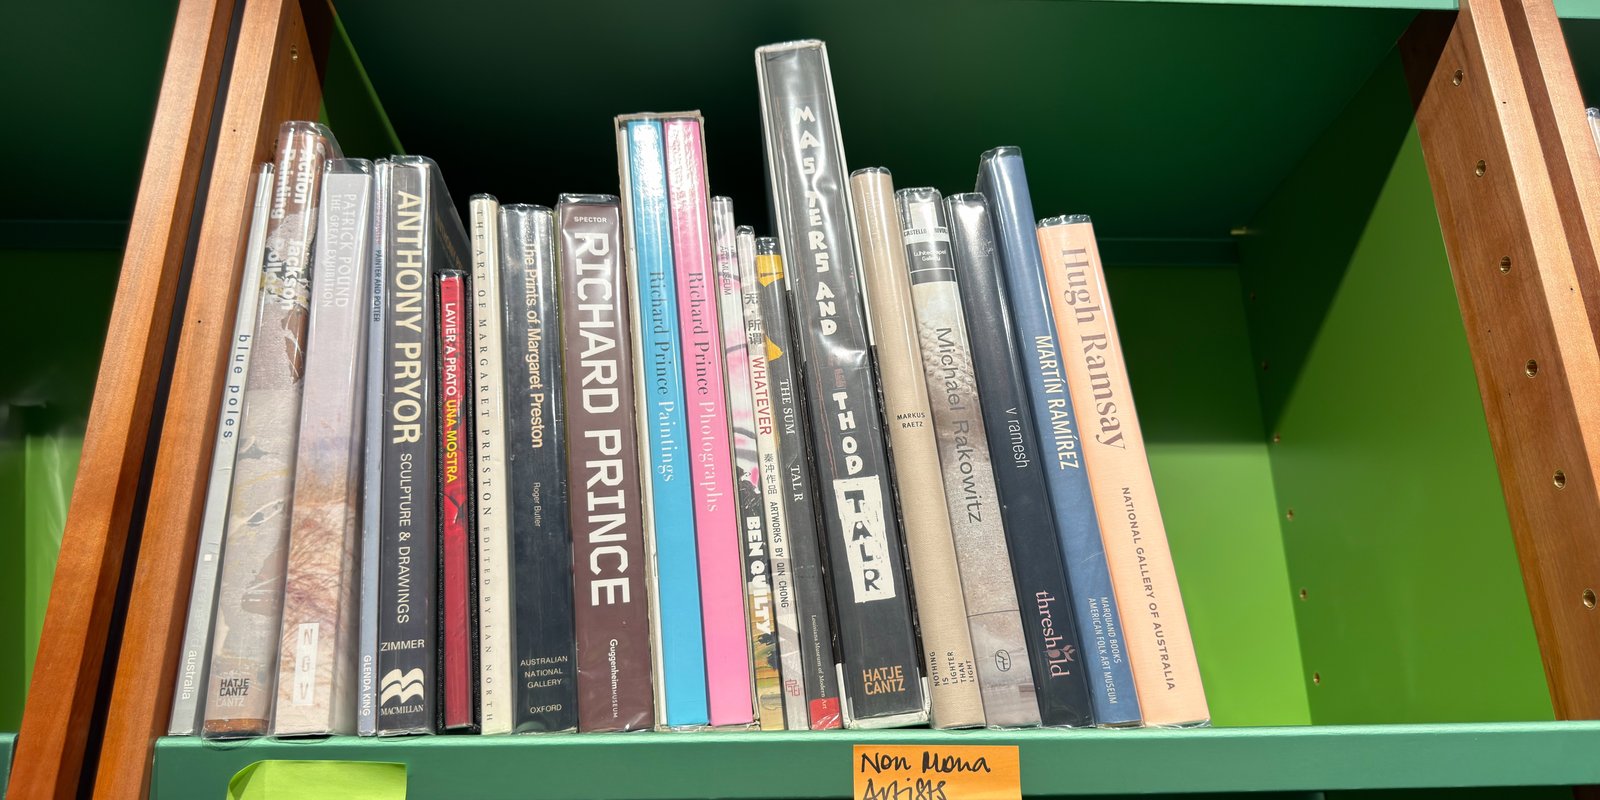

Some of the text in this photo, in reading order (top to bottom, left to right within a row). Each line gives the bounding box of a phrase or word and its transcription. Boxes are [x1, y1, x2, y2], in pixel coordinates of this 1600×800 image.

[271, 149, 296, 219] Painting
[294, 149, 316, 204] Action
[475, 211, 484, 240] THE
[573, 216, 608, 224] SPECTOR
[793, 105, 831, 272] MASTERS
[815, 281, 838, 336] AND
[320, 193, 340, 308] THE GREAT EXHIBITION
[334, 193, 357, 309] PATRICK POUND
[373, 249, 383, 278] PAINTER
[476, 250, 485, 281] ART
[281, 238, 302, 311] Jackson
[373, 278, 382, 295] AND
[722, 261, 732, 296] MUSEUM
[371, 294, 381, 322] POTTER
[477, 289, 487, 308] OF
[478, 319, 491, 418] MARGARET
[524, 243, 545, 449] The Prints of Margaret Preston
[1062, 247, 1127, 451] Hugh Ramsay
[223, 334, 251, 439] blue poles
[445, 302, 459, 483] LAVIER A PRATO UNA MOSTRA
[649, 271, 678, 483] Richard Prince Paintings
[688, 271, 723, 512] Richard Prince Photographs
[752, 356, 772, 435] WHATEVER
[393, 190, 424, 624] ANTHONY PRYOR SCULPTURE & DRAWINGS
[573, 232, 631, 607] RICHARD PRINCE
[896, 411, 926, 421] MARKUS
[902, 421, 924, 430] RAETZ
[936, 327, 983, 524] Michael Rakowitz
[1035, 335, 1080, 470] MARTÍN RAMÍREZ
[780, 378, 804, 502] THE SUM TAL R
[1005, 407, 1031, 469] v ramesh
[482, 429, 492, 516] PRESTON
[532, 482, 542, 528] Roger Butler
[746, 516, 773, 636] BEN QUILTY
[770, 501, 790, 608] ARTWORKS BY QIN CHONG
[484, 596, 491, 614] BY
[1121, 487, 1176, 691] NATIONAL GALLERY OF AUSTRALIA
[380, 639, 425, 652] ZIMMER
[811, 614, 820, 641] Louisiana
[1100, 596, 1122, 664] MARQUAND BOOKS
[520, 655, 568, 667] AUSTRALIAN
[524, 667, 563, 678] NATIONAL
[862, 665, 904, 683] HATJE
[929, 651, 941, 687] NOTHING
[946, 651, 958, 685] LIGHTER
[958, 662, 968, 684] THAN
[965, 659, 975, 684] LIGHT
[1088, 597, 1119, 705] AMERICAN FOLK ART MUSEUM
[182, 650, 198, 700] australia
[219, 687, 249, 697] CANTZ
[220, 678, 250, 688] HATJE
[362, 655, 372, 716] GLENDA KING
[527, 678, 562, 689] GALLERY
[864, 679, 906, 696] CANTZ
[942, 677, 950, 686] IS
[380, 704, 424, 716] MACMILLAN
[530, 703, 562, 714] OXFORD
[861, 750, 991, 774] Non Mona
